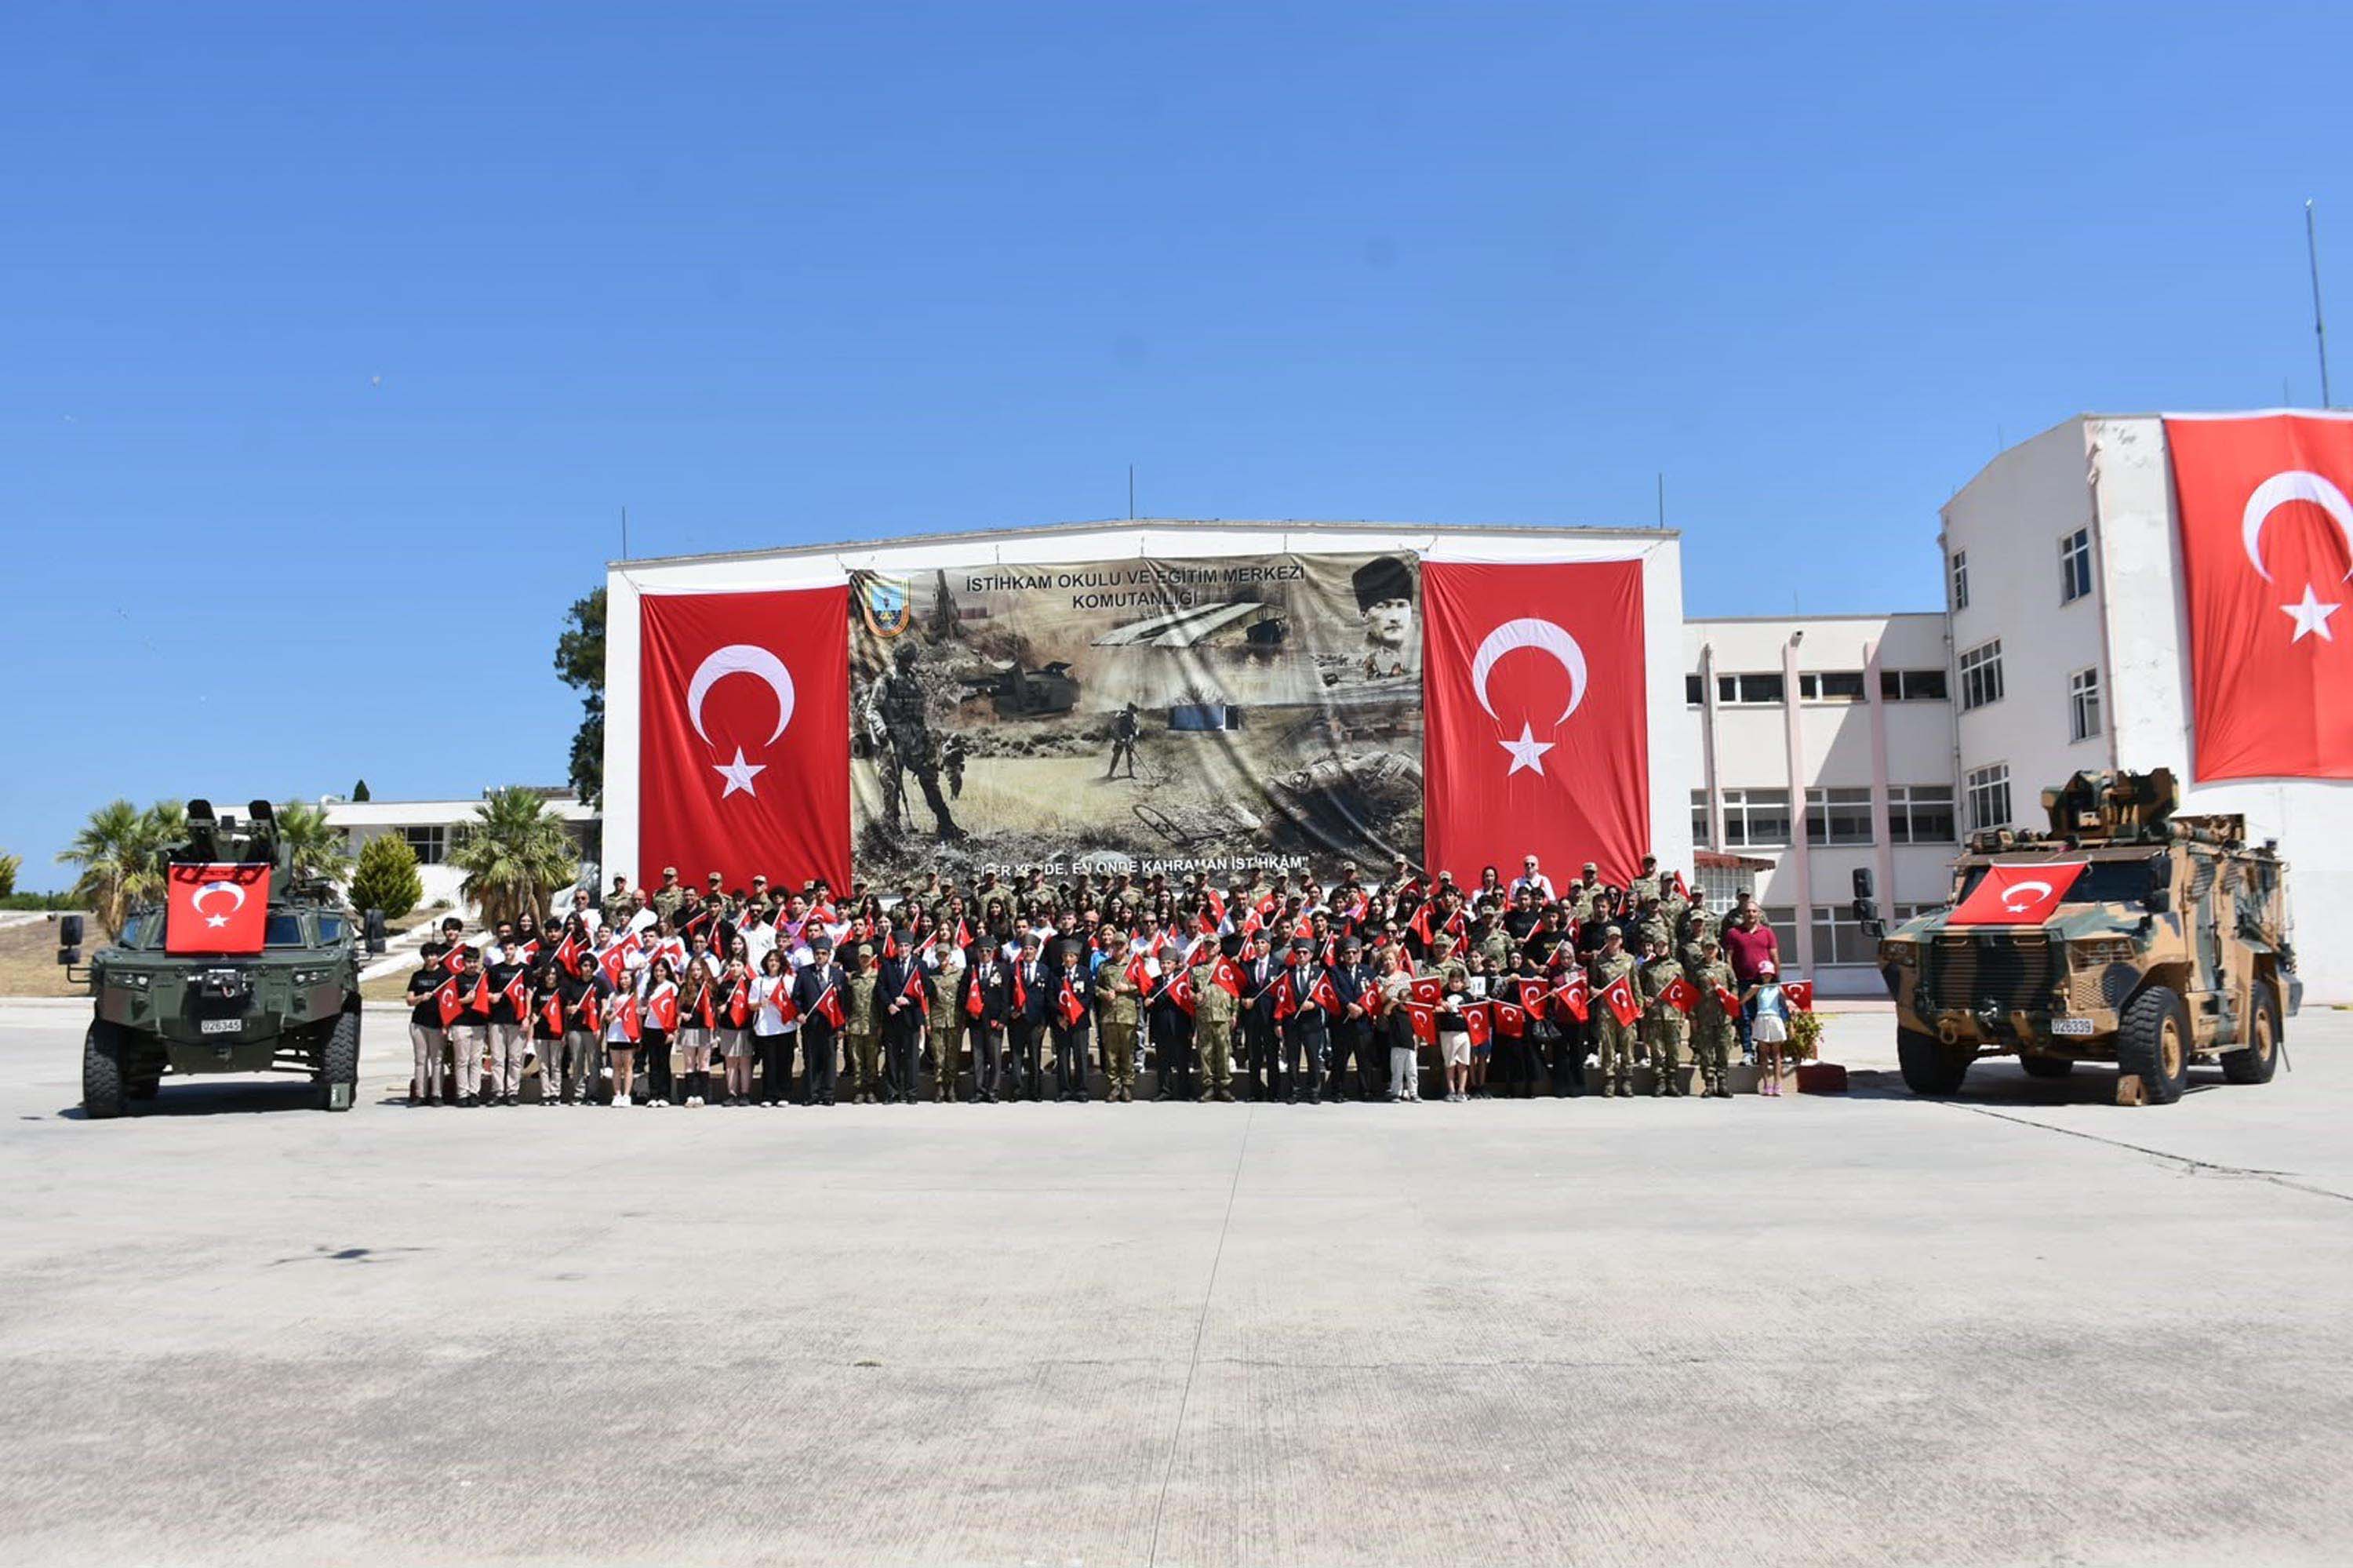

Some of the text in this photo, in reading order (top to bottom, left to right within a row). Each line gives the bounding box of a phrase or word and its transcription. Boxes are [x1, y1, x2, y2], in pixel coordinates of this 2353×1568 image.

[966, 574, 1052, 592] İSTİHKAM
[1058, 571, 1121, 588] OKULU
[1127, 569, 1150, 584] VE
